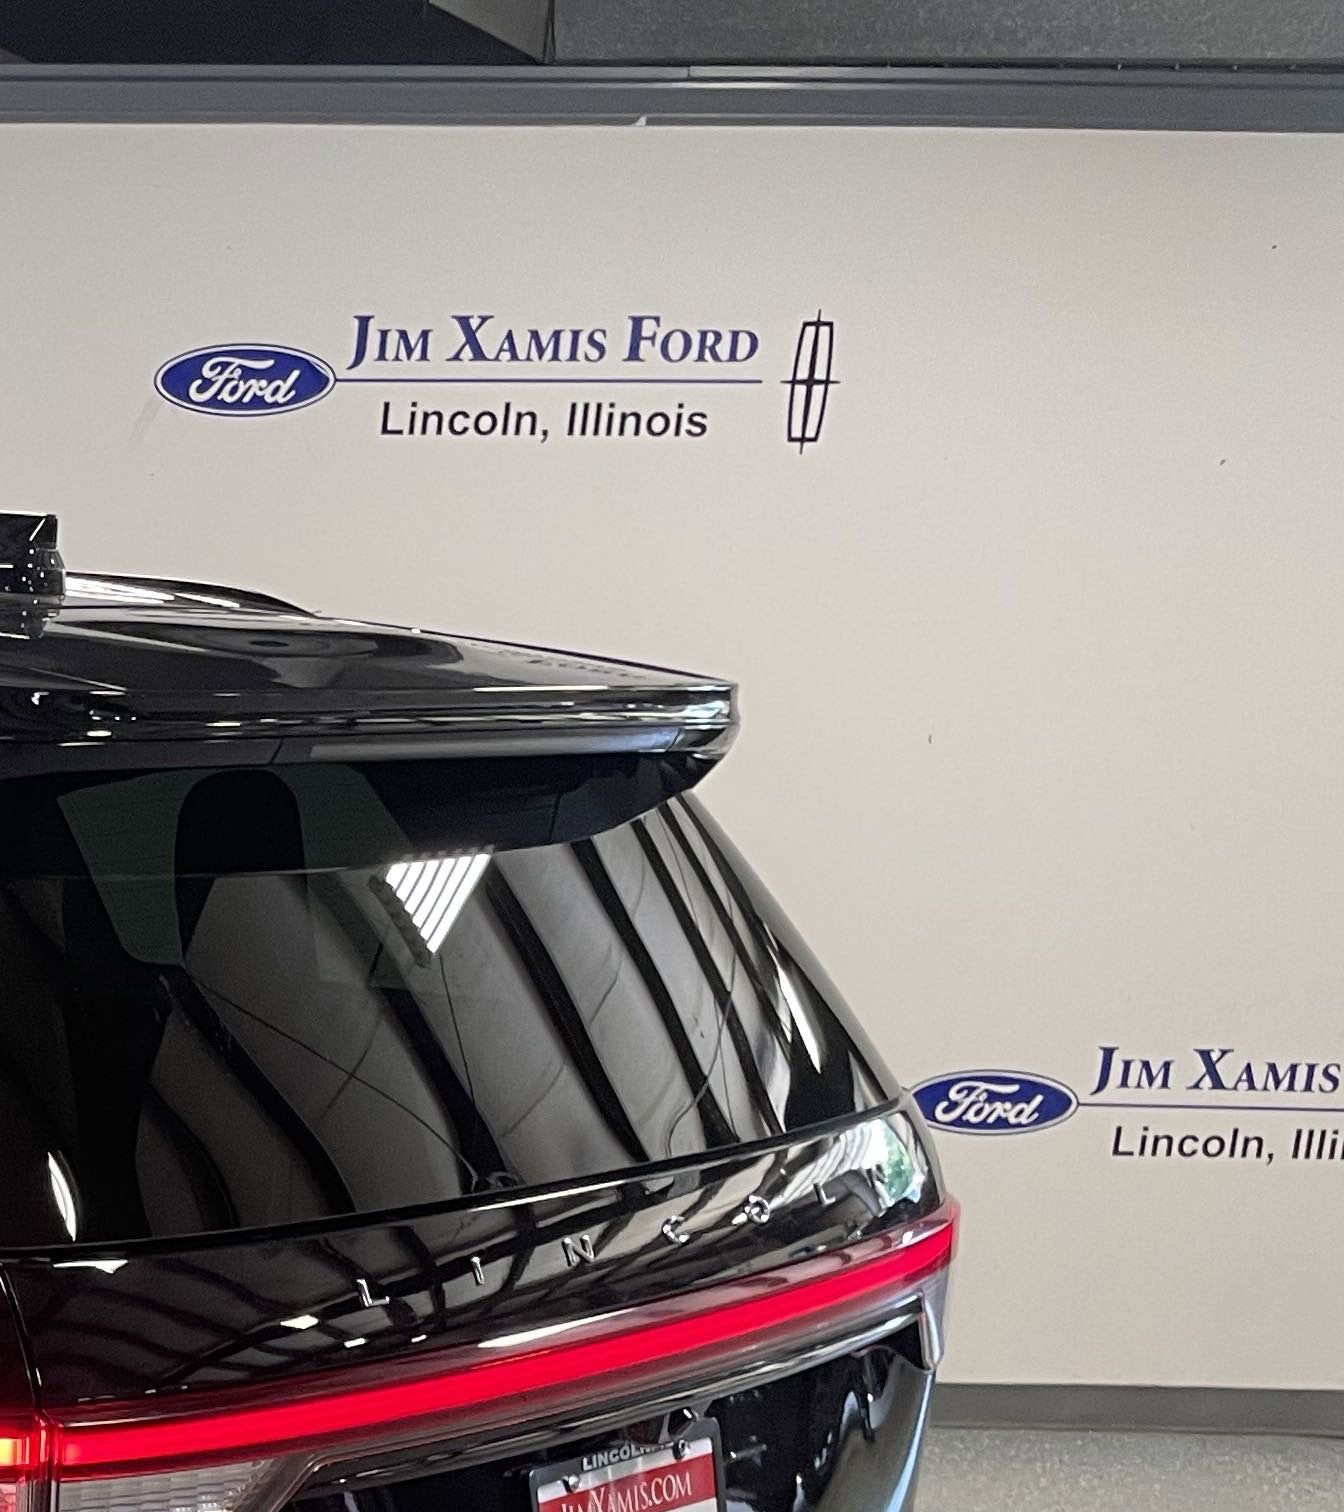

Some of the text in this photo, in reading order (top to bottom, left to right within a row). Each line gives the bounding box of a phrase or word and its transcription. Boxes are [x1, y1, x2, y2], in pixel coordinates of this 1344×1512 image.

[346, 314, 760, 370] JIM XAMIS FORD
[188, 355, 297, 406] Ford
[380, 400, 709, 445] Lincoln, Illinois
[1089, 1045, 1342, 1097] JIM XAMIS
[934, 1079, 1045, 1126] Ford
[1112, 1125, 1344, 1166] Lincoln, Illi
[355, 1163, 895, 1309] LINCOLN
